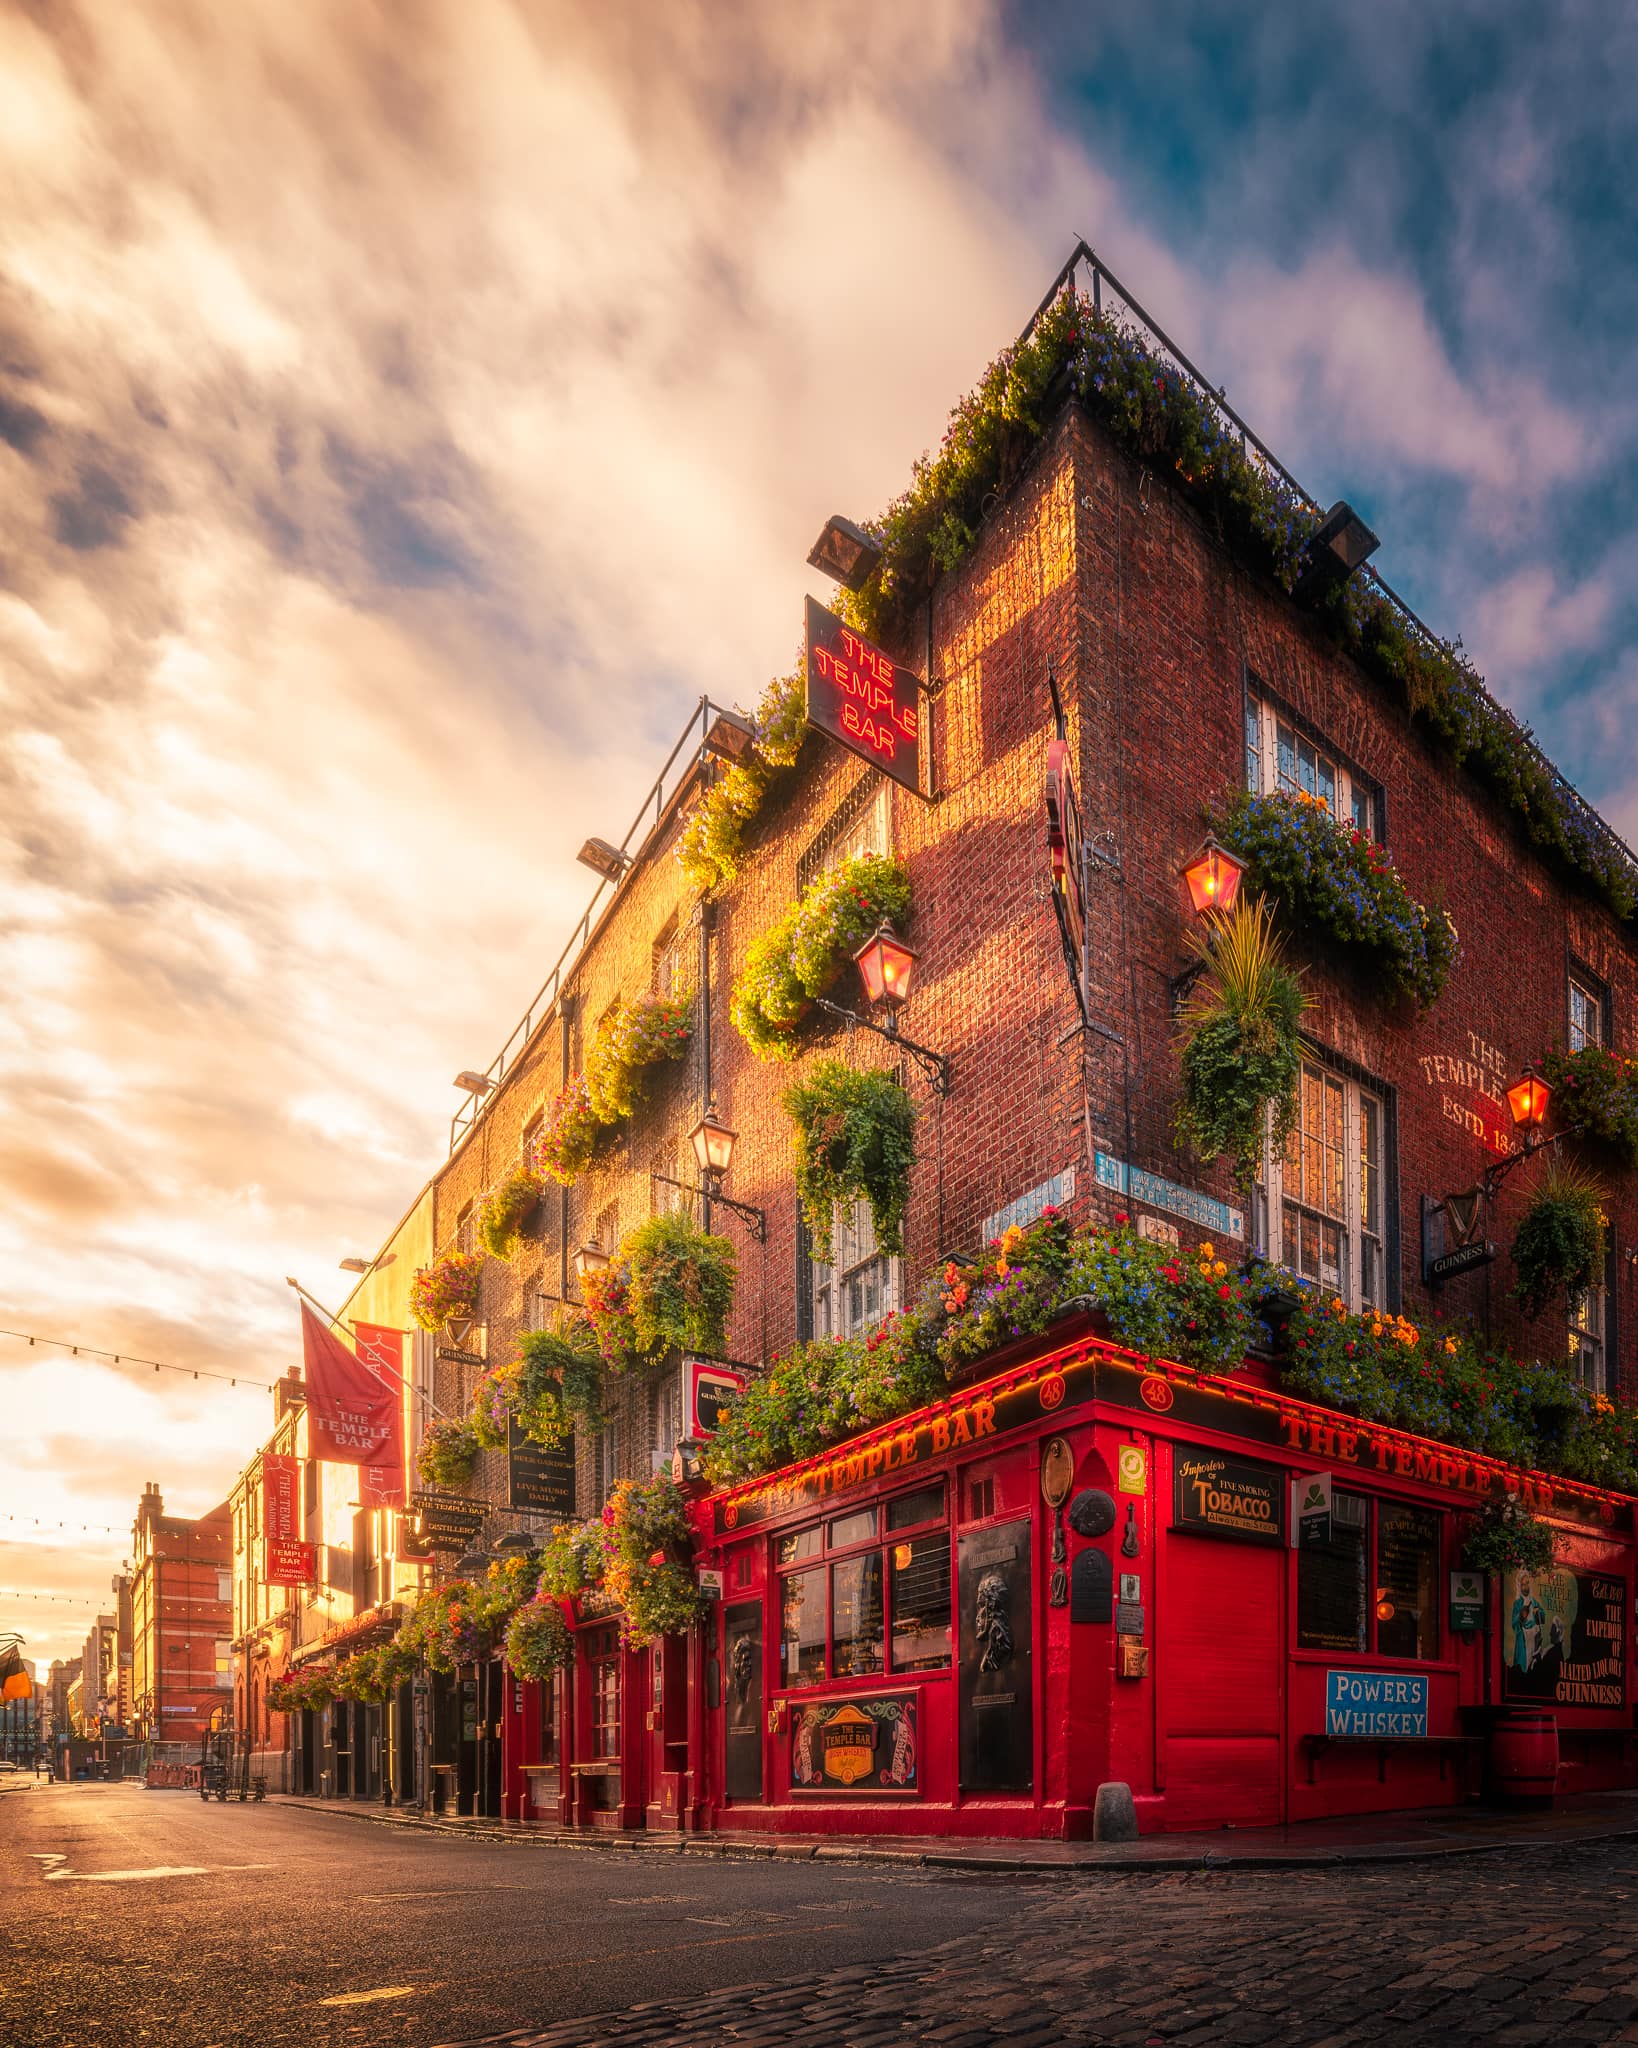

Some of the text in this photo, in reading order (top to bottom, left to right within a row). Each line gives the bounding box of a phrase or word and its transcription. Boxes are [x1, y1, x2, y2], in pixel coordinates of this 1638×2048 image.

[841, 628, 893, 687] THE
[815, 647, 917, 737] TEMPLE
[843, 703, 895, 757] BAR
[1467, 1031, 1507, 1079] THE
[1418, 1055, 1503, 1107] TEMPLE
[1434, 1244, 1484, 1273] GUINNESS
[1043, 1382, 1060, 1404] 48
[1146, 1383, 1166, 1404] 48
[314, 1417, 392, 1439] TEMPLE
[337, 1410, 369, 1425] THE
[335, 1434, 373, 1449] BAR
[811, 1434, 919, 1496] TEMPLE
[931, 1403, 997, 1454] BAR
[1280, 1414, 1359, 1463] THE
[1370, 1437, 1492, 1496] TEMPLE
[1179, 1460, 1225, 1480] Importers
[516, 1482, 569, 1496] LIVE MUSIC
[529, 1492, 557, 1502] DAILY
[1220, 1479, 1270, 1497] FINE SMOKING
[280, 1475, 291, 1539] THE TEMPL
[416, 1500, 486, 1515] THE TEMPLE BAR
[1191, 1479, 1271, 1520] TOBACCO
[428, 1523, 476, 1534] DISTILLERY
[1208, 1511, 1240, 1526] Always
[271, 1548, 310, 1559] TEMPLE
[279, 1557, 300, 1565] BAR
[1605, 1604, 1622, 1621] THE
[1586, 1619, 1623, 1641] EMPEROR
[1612, 1640, 1622, 1658] OF
[1559, 1660, 1591, 1681] MALTED
[1335, 1675, 1421, 1704] POWER'S
[1555, 1681, 1623, 1705] GUINNESS
[841, 1725, 854, 1734] THE
[1329, 1708, 1425, 1735] WHISKEY
[825, 1734, 871, 1746] TEMPLE BAR
